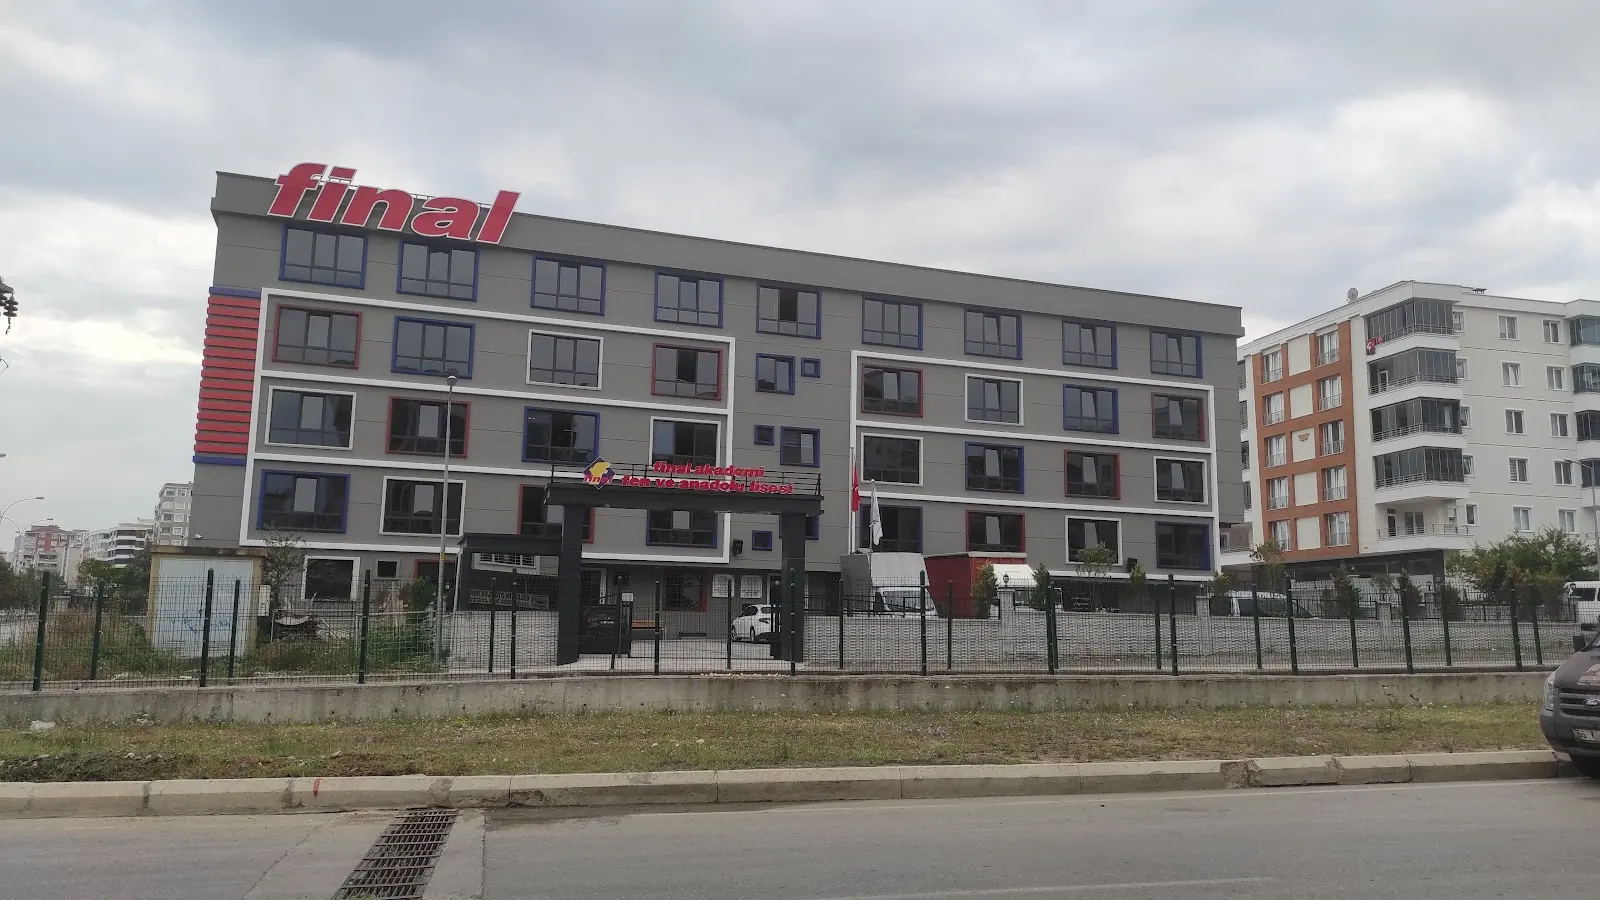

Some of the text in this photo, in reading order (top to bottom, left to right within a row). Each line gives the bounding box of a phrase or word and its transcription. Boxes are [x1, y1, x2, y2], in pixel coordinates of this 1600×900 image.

[267, 162, 521, 244] final
[653, 461, 764, 478] final akademi
[621, 474, 794, 494] fen ve anadolu lisesi
